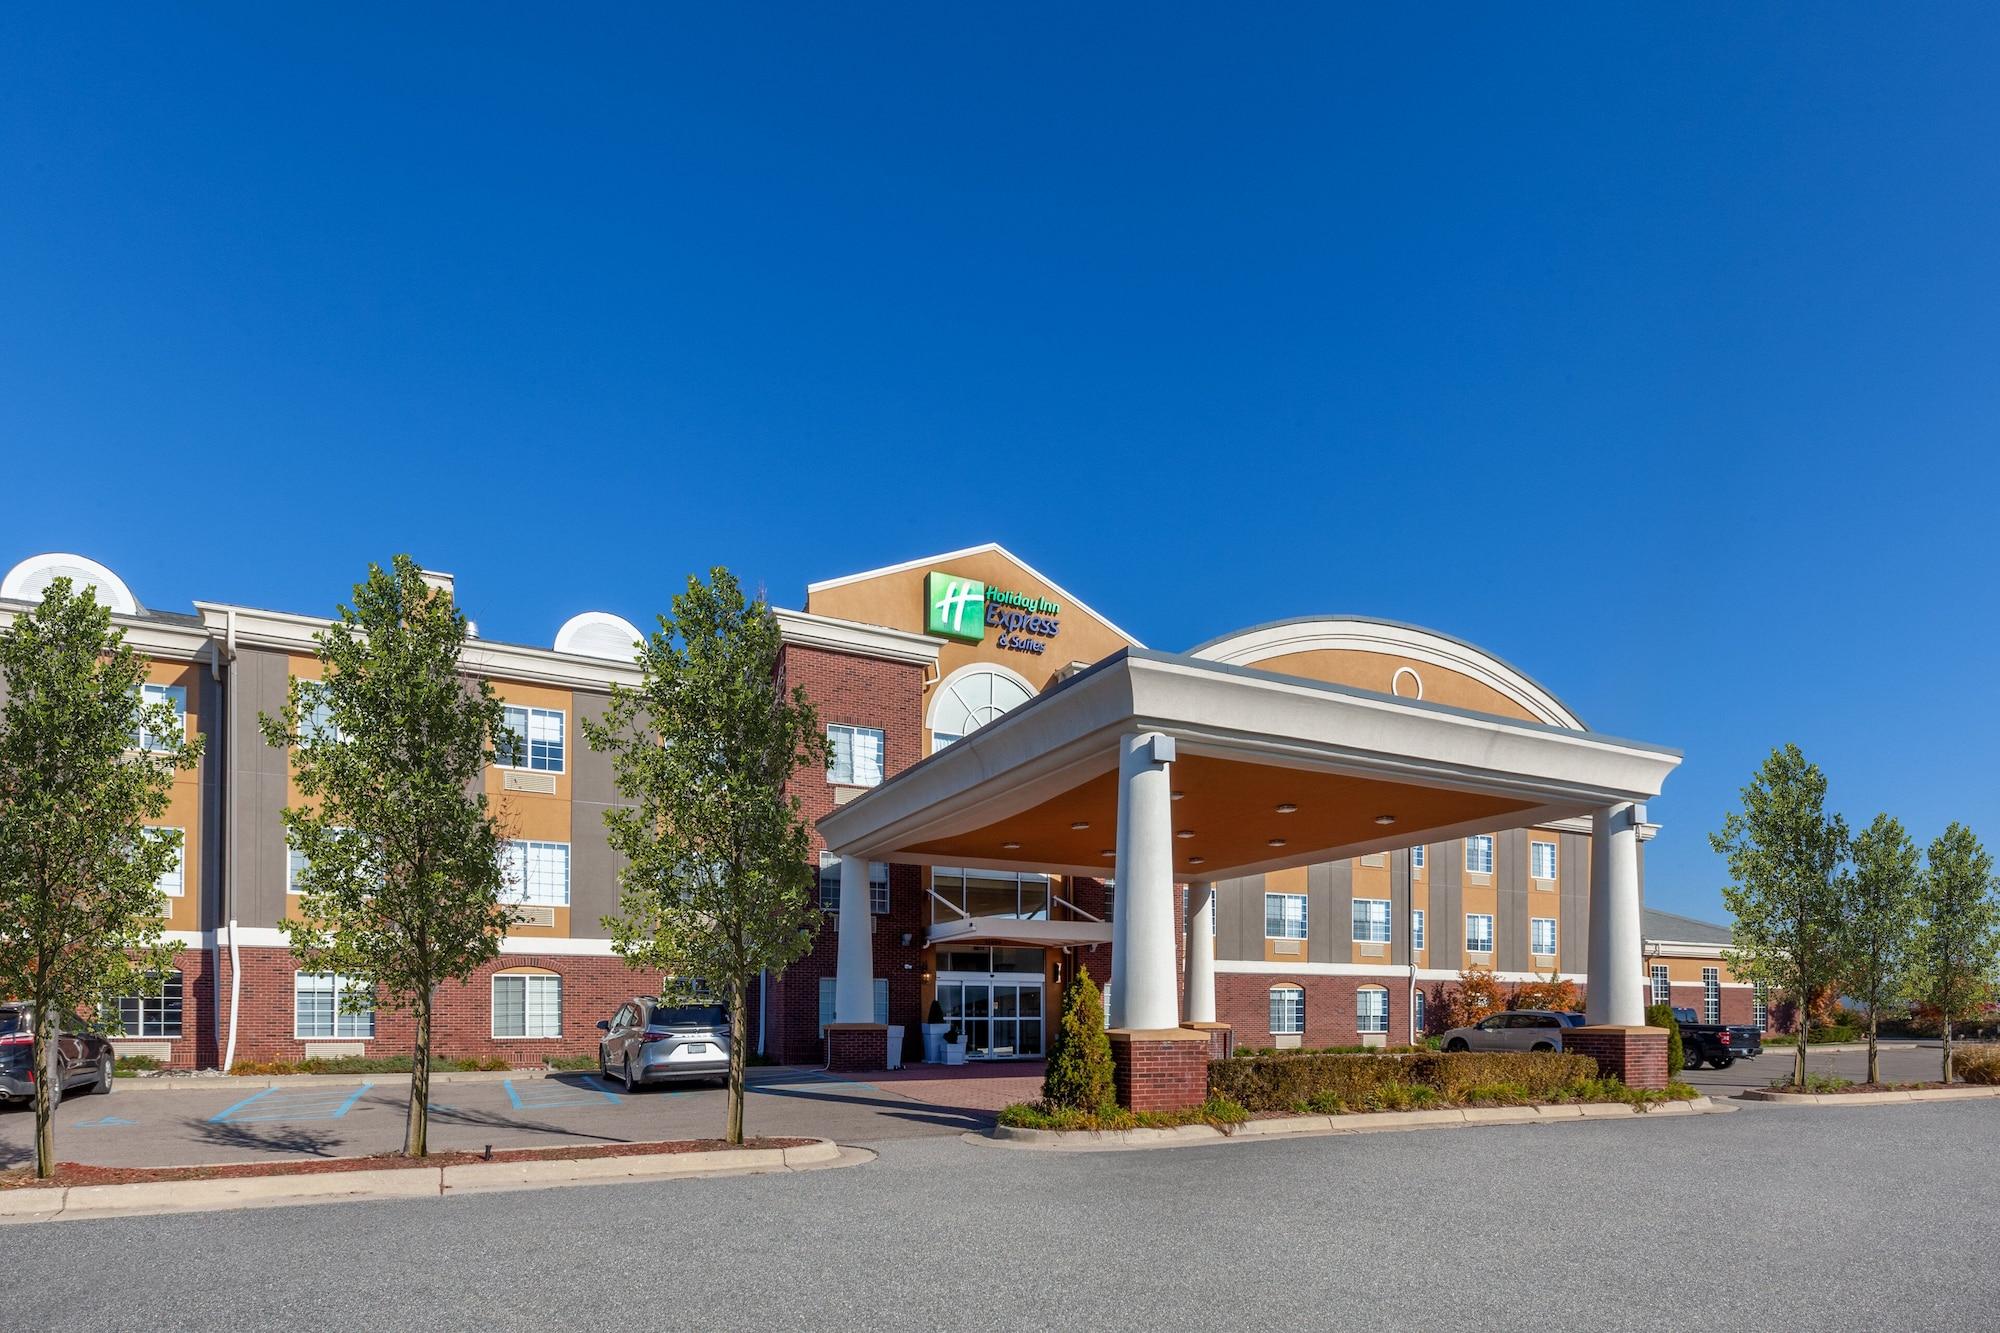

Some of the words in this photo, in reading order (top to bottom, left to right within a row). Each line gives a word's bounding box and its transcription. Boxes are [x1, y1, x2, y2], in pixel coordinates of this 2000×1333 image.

[985, 585, 1038, 612] Holiday
[1039, 595, 1060, 614] Inn
[986, 602, 1060, 635] Express
[999, 633, 1008, 646] &
[1010, 636, 1046, 653] Suites
